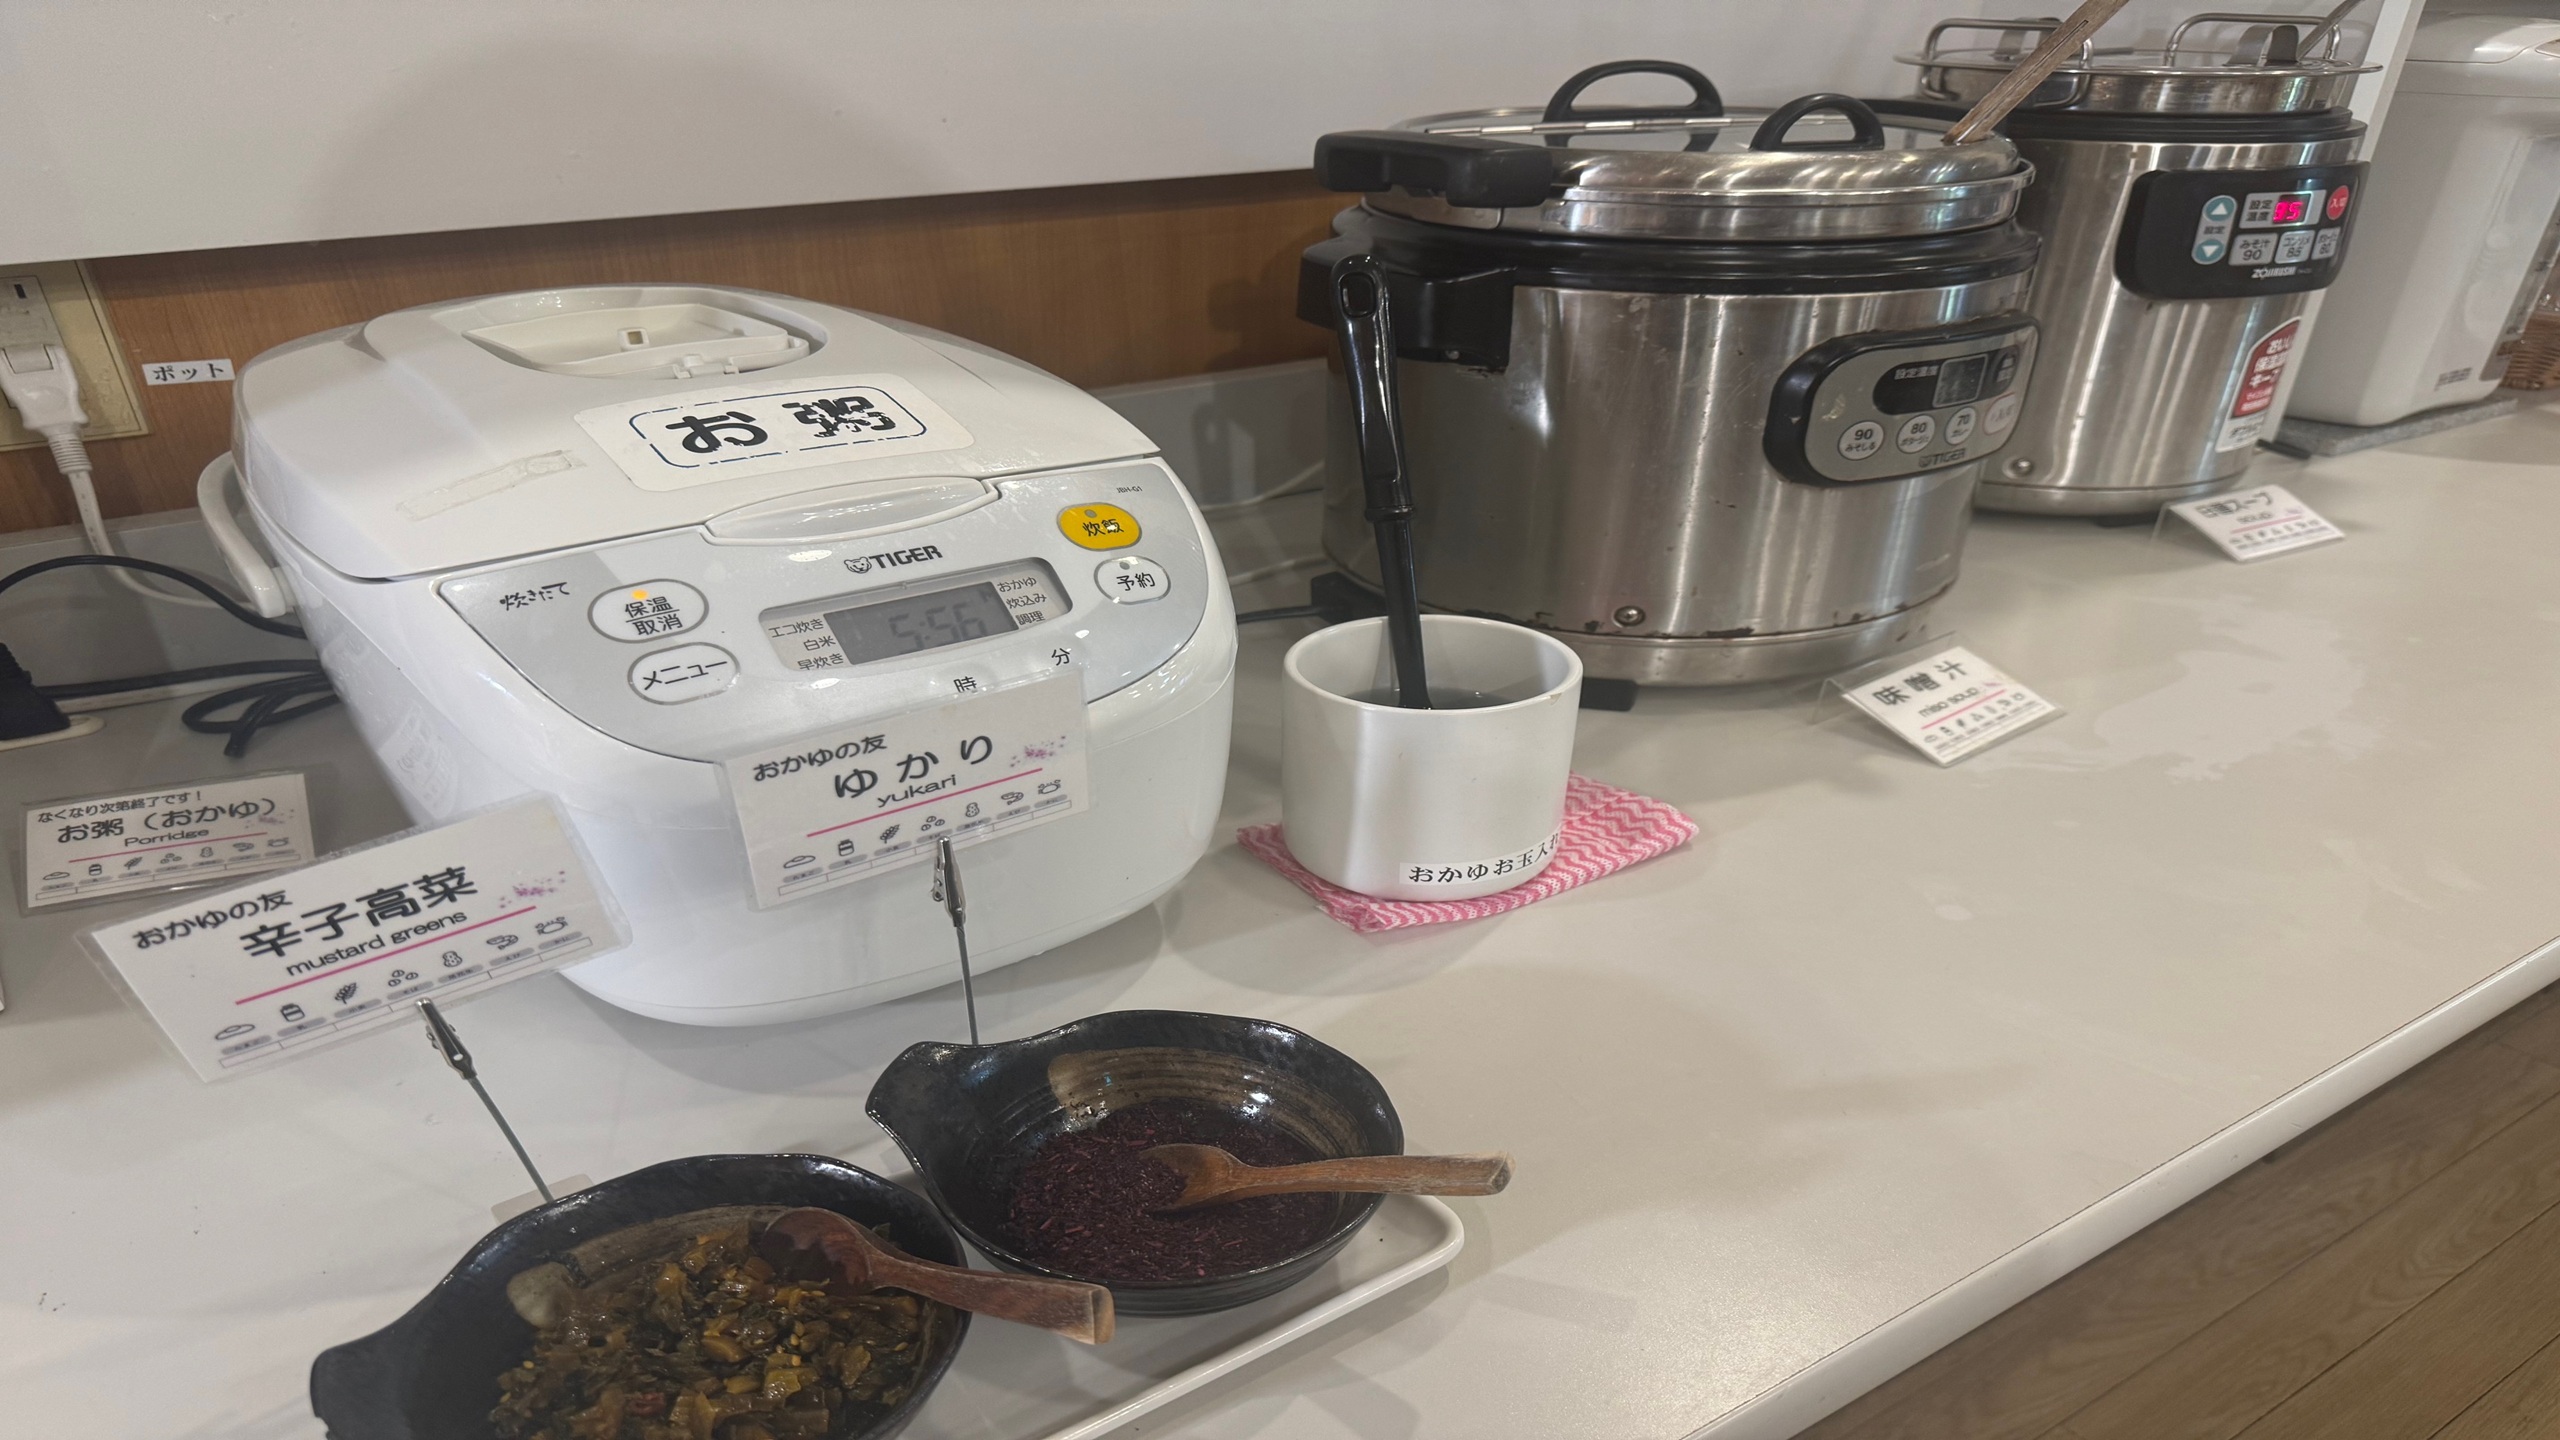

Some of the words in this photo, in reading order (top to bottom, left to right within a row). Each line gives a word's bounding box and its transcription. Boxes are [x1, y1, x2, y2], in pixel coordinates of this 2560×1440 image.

[2243, 250, 2262, 261] 90
[153, 363, 224, 381] ポット
[665, 396, 896, 453] お粥
[1911, 423, 1927, 434] 80
[1854, 429, 1873, 440] 90
[1082, 519, 1124, 537] 炊飯
[869, 544, 943, 570] TIGER
[997, 576, 1037, 593] おかゆ
[1116, 572, 1156, 591] 予約
[500, 582, 570, 610] 炊きたて
[1006, 593, 1047, 609] 炊込み
[625, 596, 673, 618] 保温
[633, 613, 683, 636] 取消
[1015, 610, 1046, 625] 調理
[768, 619, 825, 638] エコ炊き
[803, 635, 836, 651] 白米
[797, 653, 844, 671] 早炊き
[1051, 648, 1071, 666] 分
[643, 661, 727, 690] メニュー
[953, 675, 978, 693] 時
[1872, 660, 1967, 706] 味噌汁
[753, 734, 888, 782] おかゆの友
[834, 735, 992, 799] ゆかり
[877, 774, 956, 808] yukari
[124, 829, 209, 847] Porridge
[131, 890, 293, 949] おかゆの友
[240, 866, 479, 960] 辛子高菜
[286, 934, 386, 977] mustard
[390, 910, 467, 949] greens
